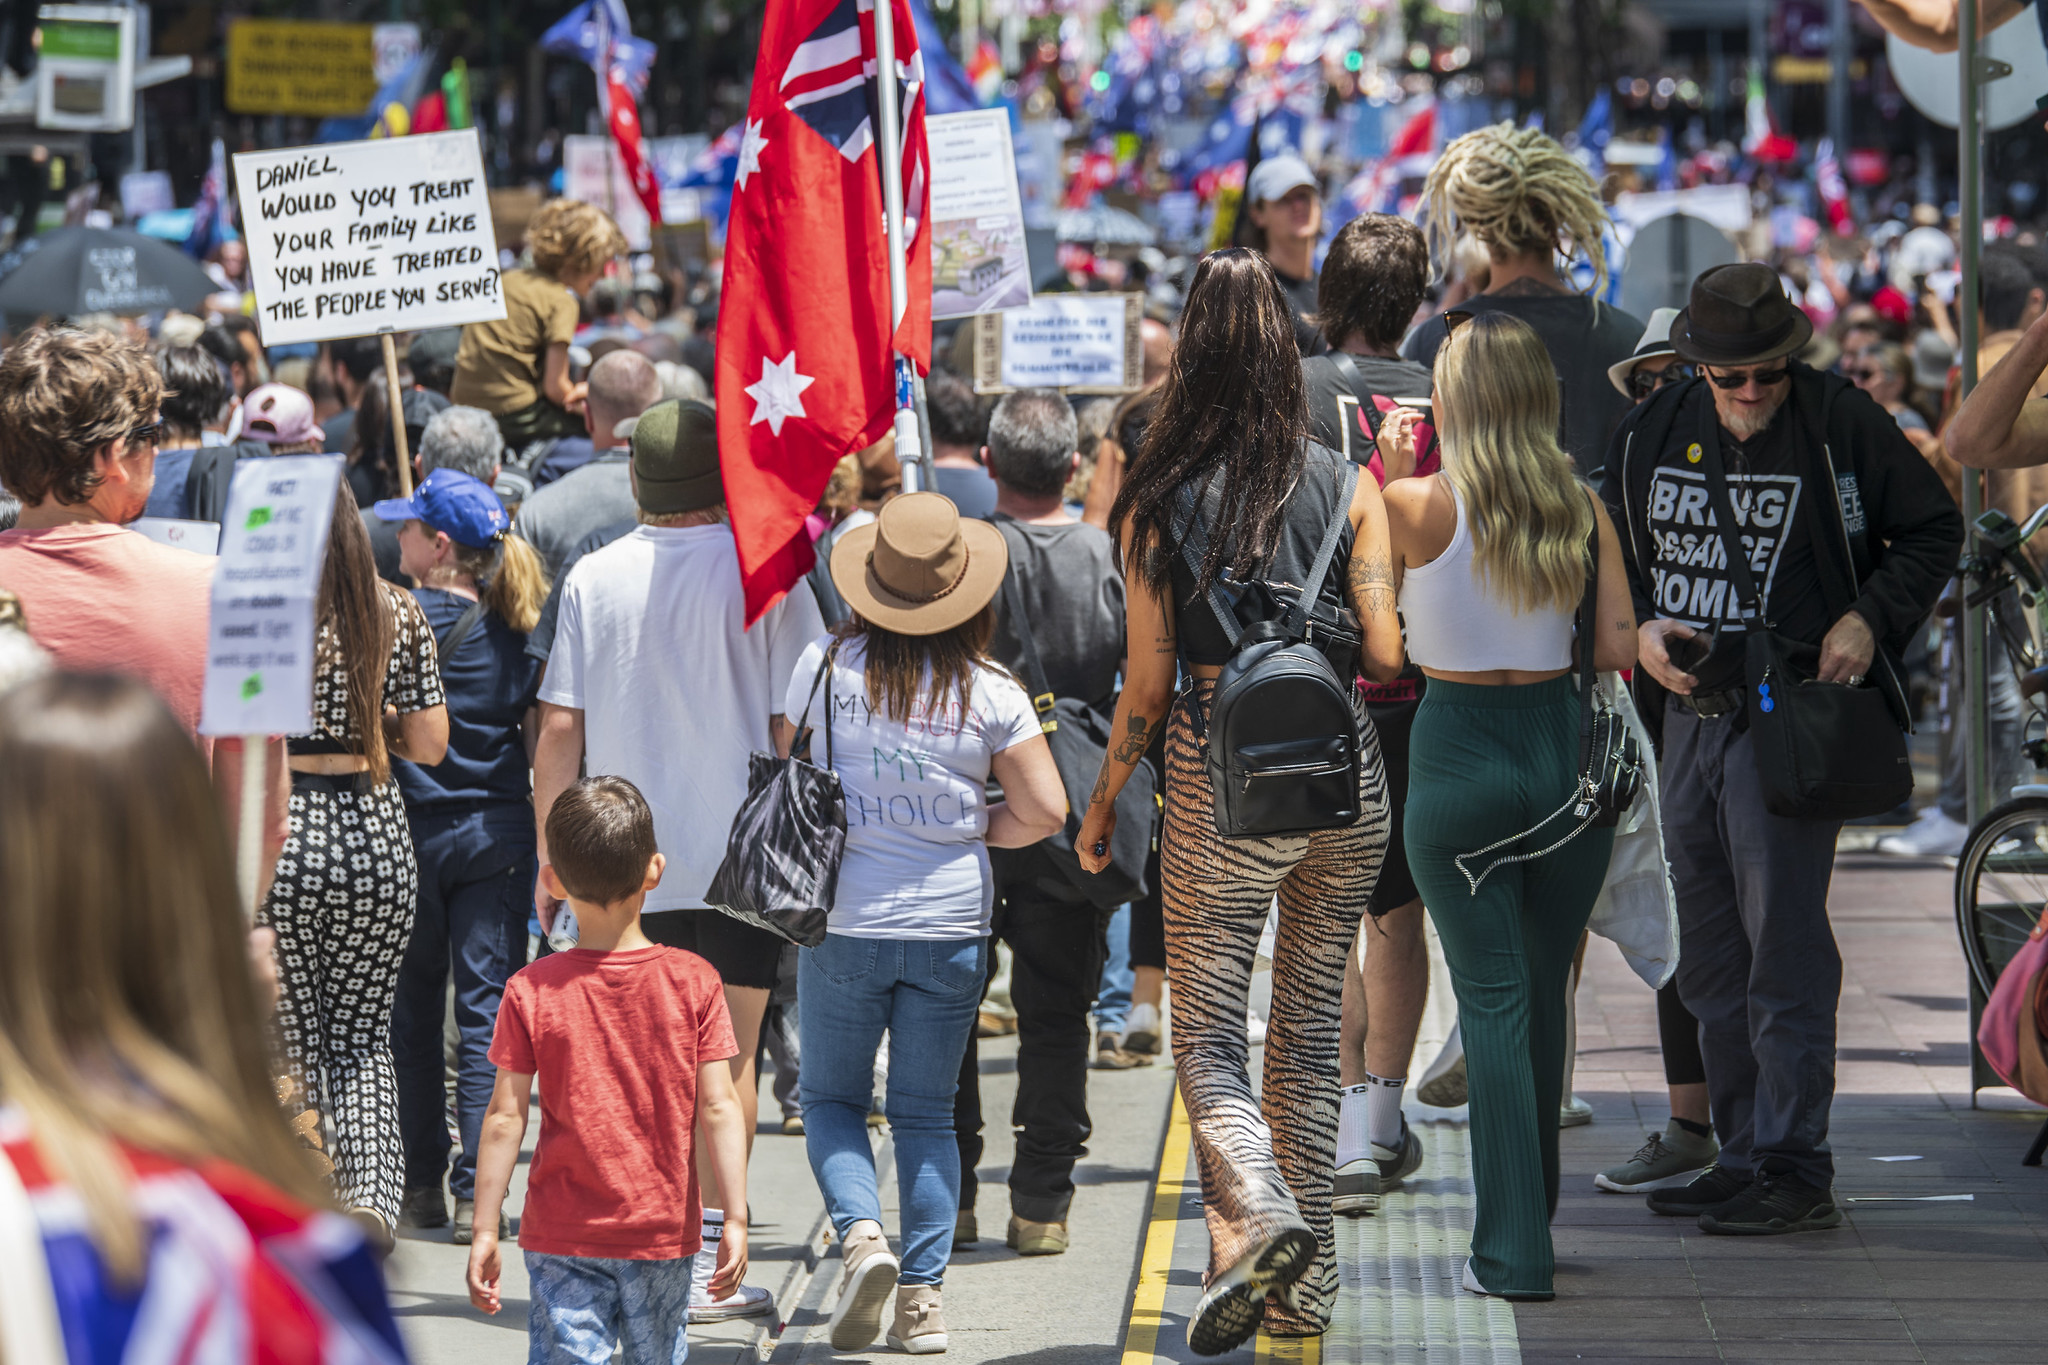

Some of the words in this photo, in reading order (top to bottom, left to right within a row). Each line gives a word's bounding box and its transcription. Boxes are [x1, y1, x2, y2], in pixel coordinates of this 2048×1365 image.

[261, 192, 337, 220] WOULD
[350, 186, 397, 217] YOU
[409, 178, 475, 205] TREAT
[273, 228, 334, 259] YOUR
[275, 266, 313, 292] YOU
[321, 258, 377, 283] HAVE
[393, 246, 482, 274] TREATED
[266, 298, 308, 321] THE
[315, 289, 386, 319] PEOPLE
[391, 287, 425, 310] YOU
[436, 267, 500, 303] SERVE?
[832, 693, 878, 727] MY
[905, 699, 988, 738] BODY
[872, 746, 929, 782] MY
